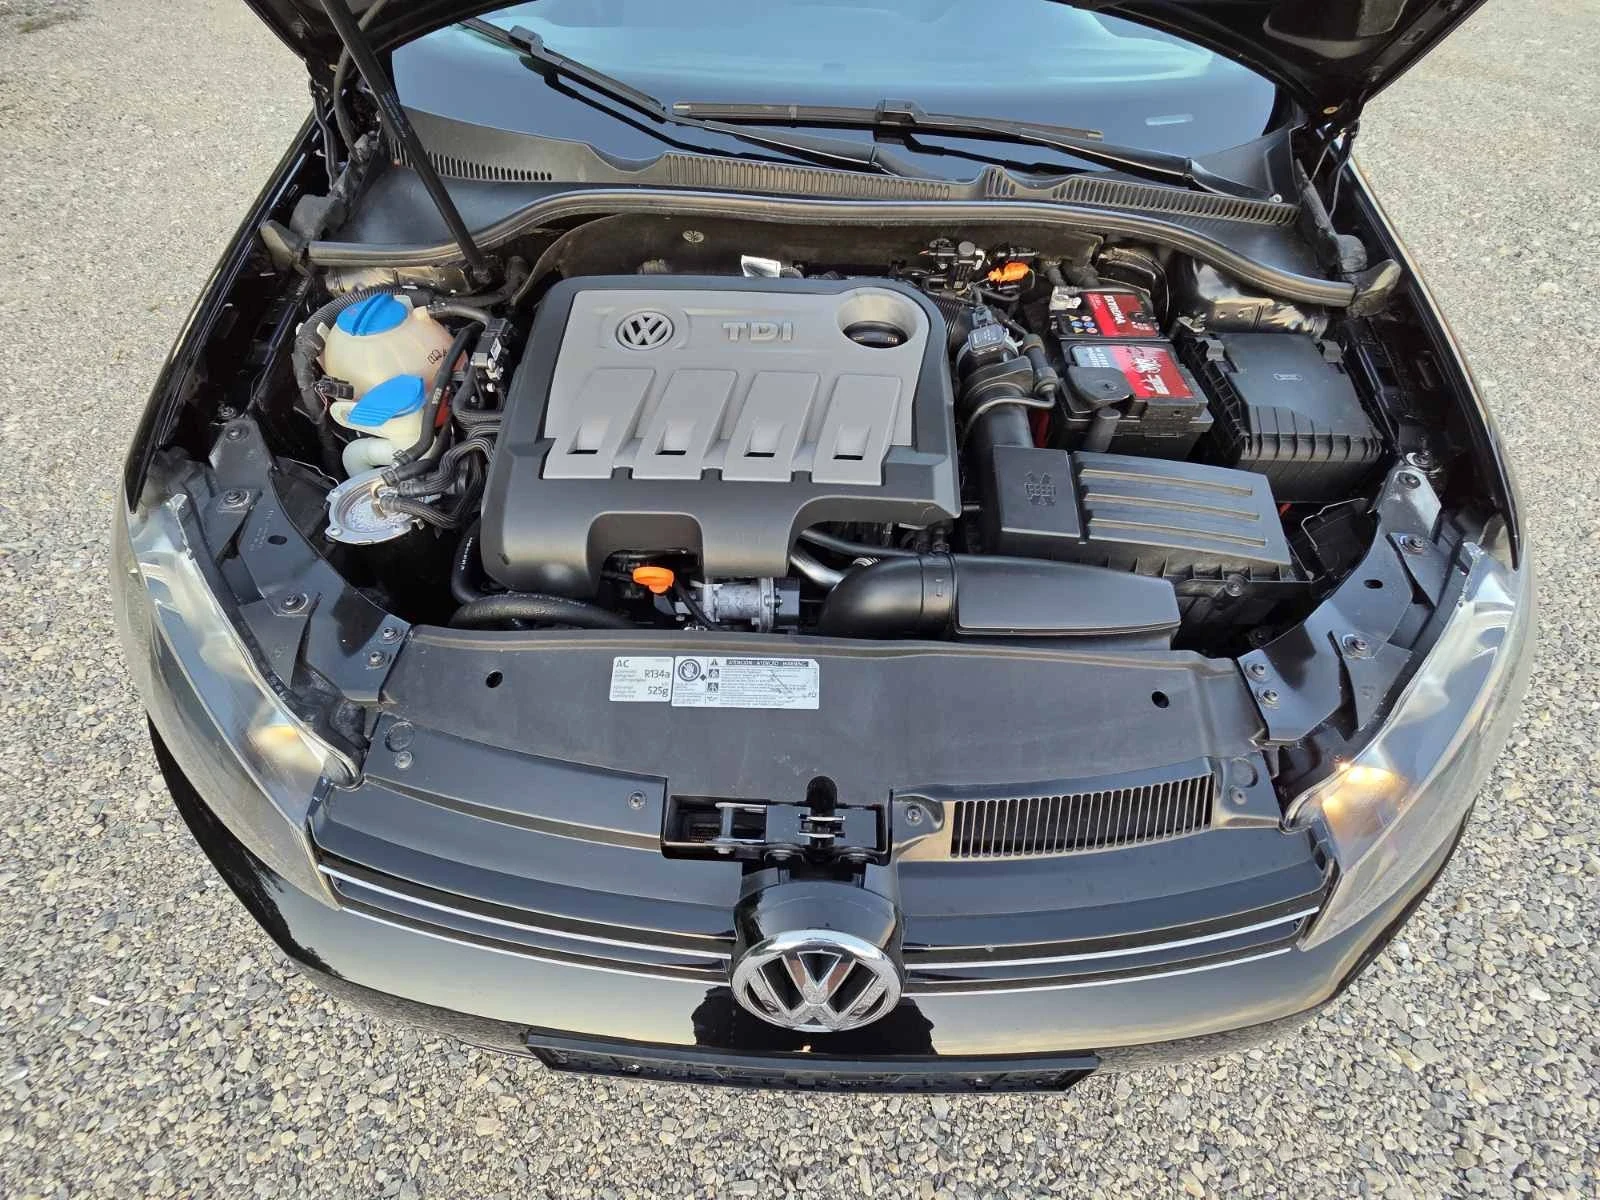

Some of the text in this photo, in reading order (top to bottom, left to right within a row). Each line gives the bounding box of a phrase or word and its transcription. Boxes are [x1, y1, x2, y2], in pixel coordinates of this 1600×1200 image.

[617, 311, 673, 349] VW
[721, 320, 794, 341] TDI
[615, 658, 631, 668] AC
[644, 669, 671, 679] R134a
[647, 686, 669, 698] 525g
[734, 934, 899, 1031] VW
